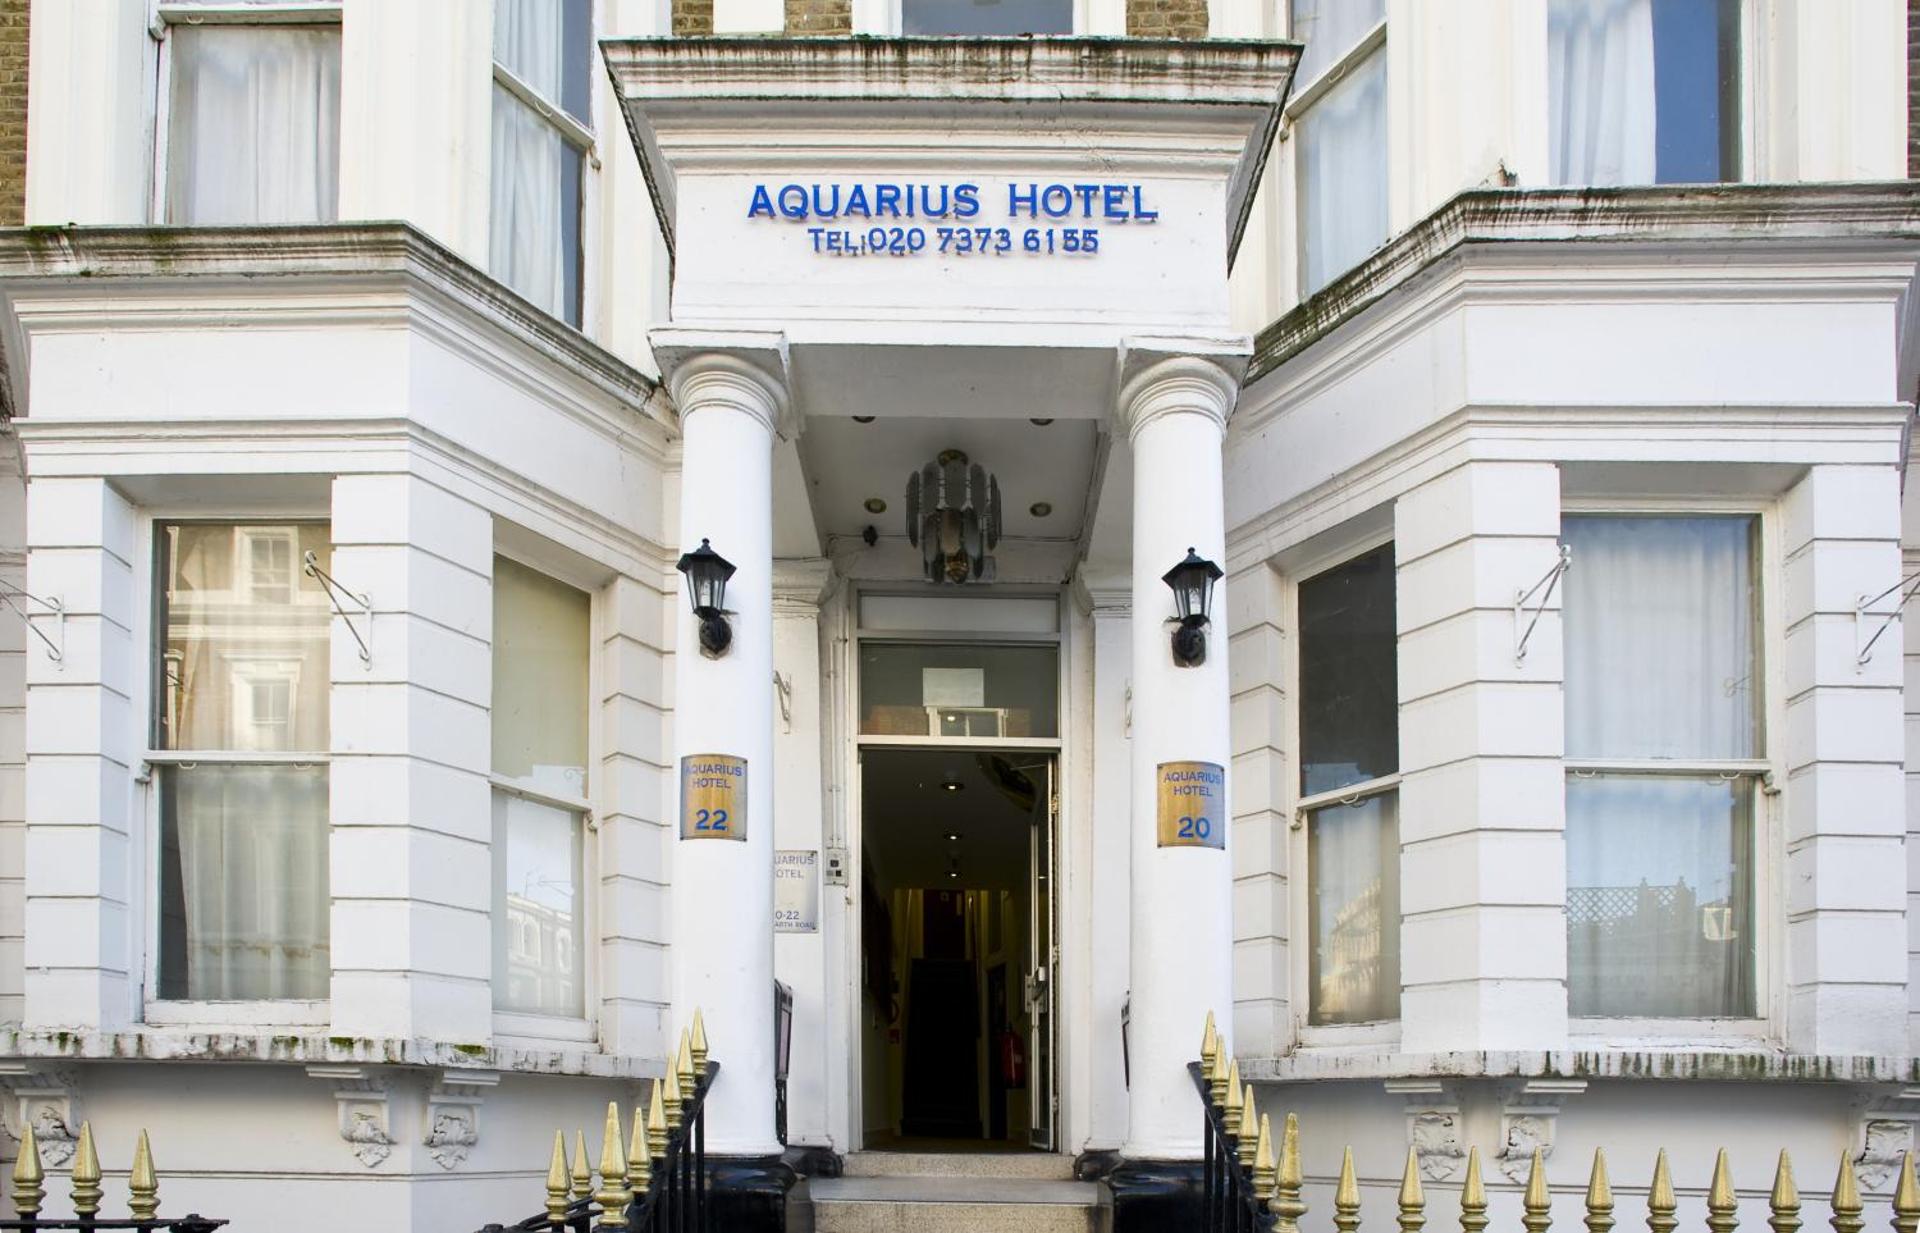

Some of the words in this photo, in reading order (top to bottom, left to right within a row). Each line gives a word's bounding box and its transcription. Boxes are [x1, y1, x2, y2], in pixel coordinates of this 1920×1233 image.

[748, 184, 980, 218] AQUARIUS
[1009, 184, 1158, 219] HOTEL
[937, 227, 1011, 253] 7373
[1023, 228, 1099, 253] 6155
[684, 763, 742, 777] AQUARIUS
[692, 777, 731, 789] HOTEL
[1164, 771, 1221, 785] AQUARIUS
[1174, 785, 1213, 797] HOTEL
[695, 808, 728, 831] 22
[1178, 816, 1211, 839] 20
[775, 855, 814, 865] UARIUS
[776, 869, 804, 878] OTEL
[775, 910, 800, 920] 0-22
